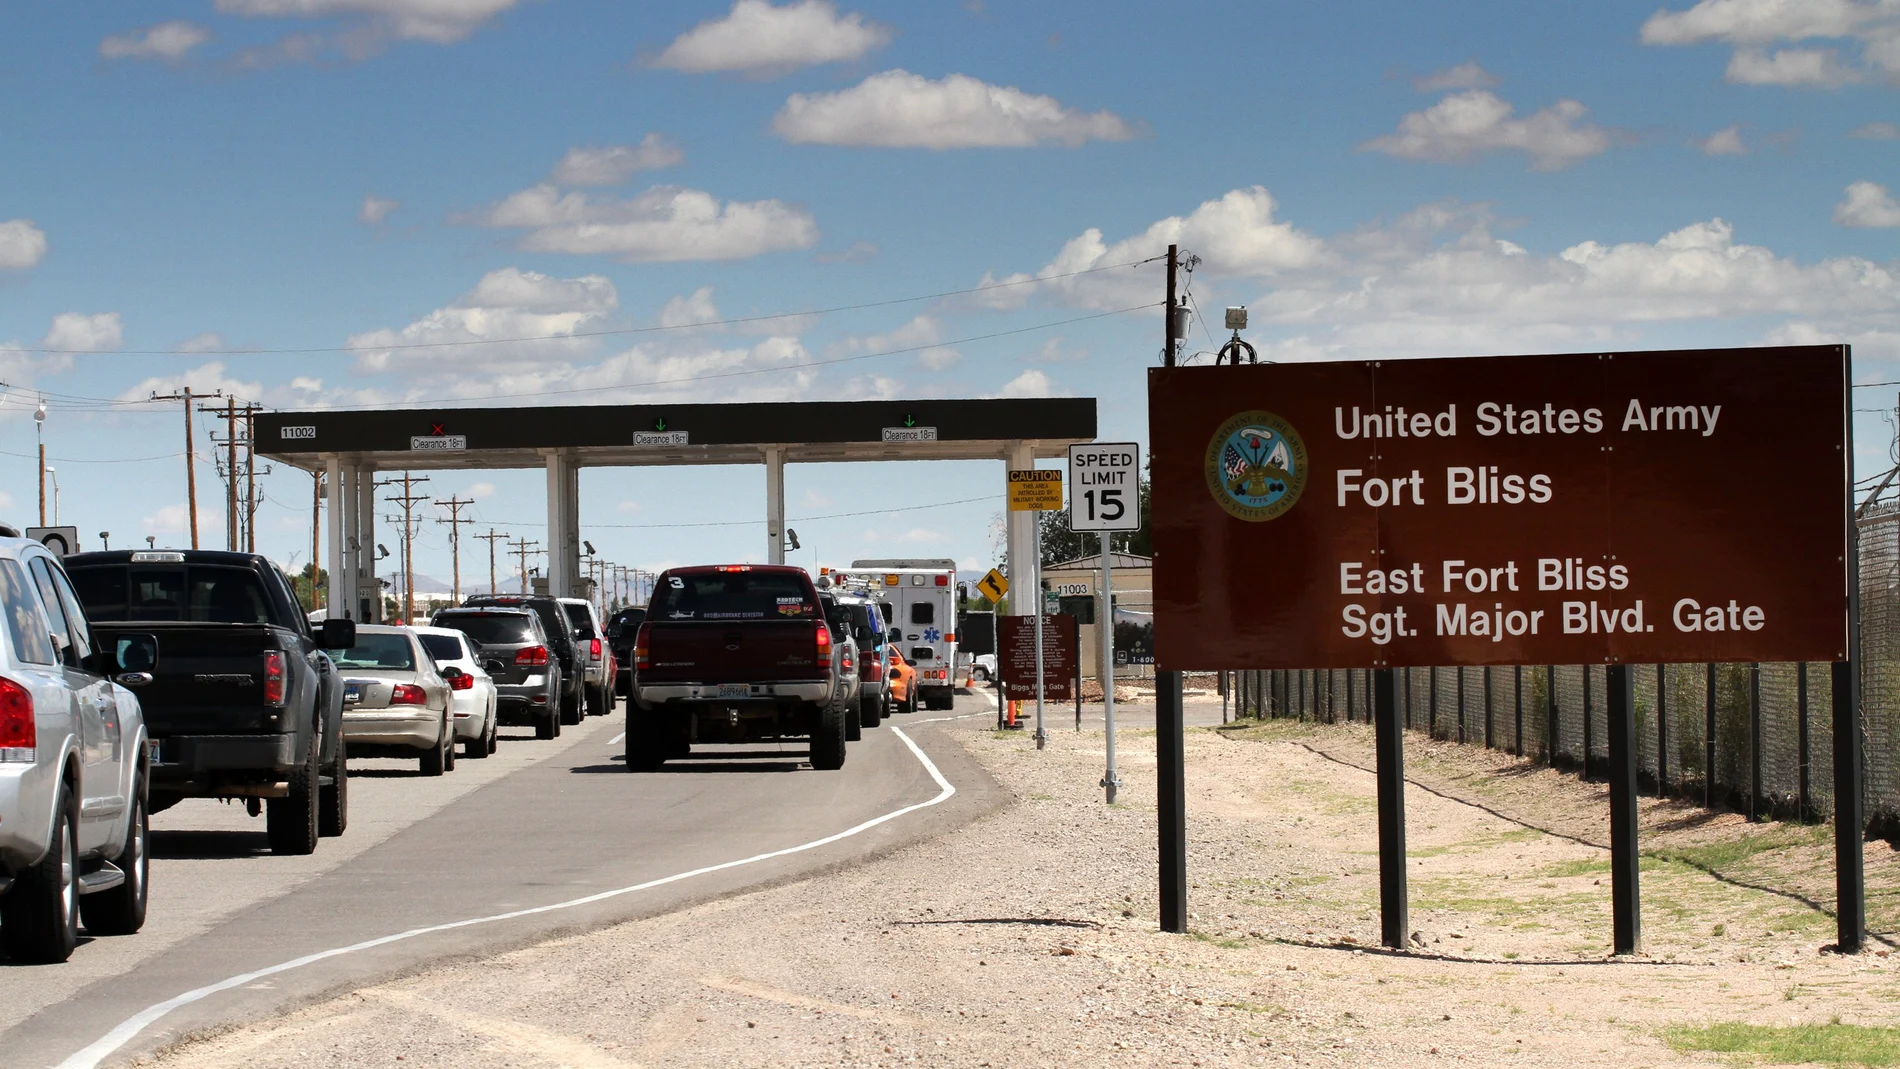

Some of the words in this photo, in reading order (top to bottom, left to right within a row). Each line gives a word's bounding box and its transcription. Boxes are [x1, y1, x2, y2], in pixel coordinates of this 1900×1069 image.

[1336, 404, 1456, 439] United
[1476, 402, 1603, 436] States
[1622, 399, 1721, 436] Army
[283, 427, 314, 438] 11002
[884, 430, 918, 440] Clearance
[920, 430, 934, 440] 18FT
[413, 438, 447, 449] Clearance
[449, 438, 463, 448] 18FT
[636, 434, 669, 444] Clearance
[672, 434, 685, 444] 18FT
[1288, 435, 1304, 461] ARMY
[1076, 453, 1132, 467] SPEED
[1010, 471, 1060, 481] CAUTION
[1081, 471, 1126, 485] LIMIT
[1337, 469, 1424, 506] Fort
[1447, 466, 1552, 504] Bliss
[1084, 489, 1125, 521] 15
[1341, 562, 1424, 594] East
[1443, 560, 1519, 592] Fort
[1538, 558, 1628, 590] Bliss
[668, 576, 685, 589] 3
[1058, 584, 1087, 594] 11003
[1023, 616, 1051, 625] NOCE
[1342, 604, 1417, 644] Sgt.
[1437, 603, 1544, 642] Major
[1563, 600, 1653, 633] Blvd.
[1673, 598, 1764, 632] Gate
[126, 675, 143, 683] Ford
[1011, 684, 1030, 692] Biggs
